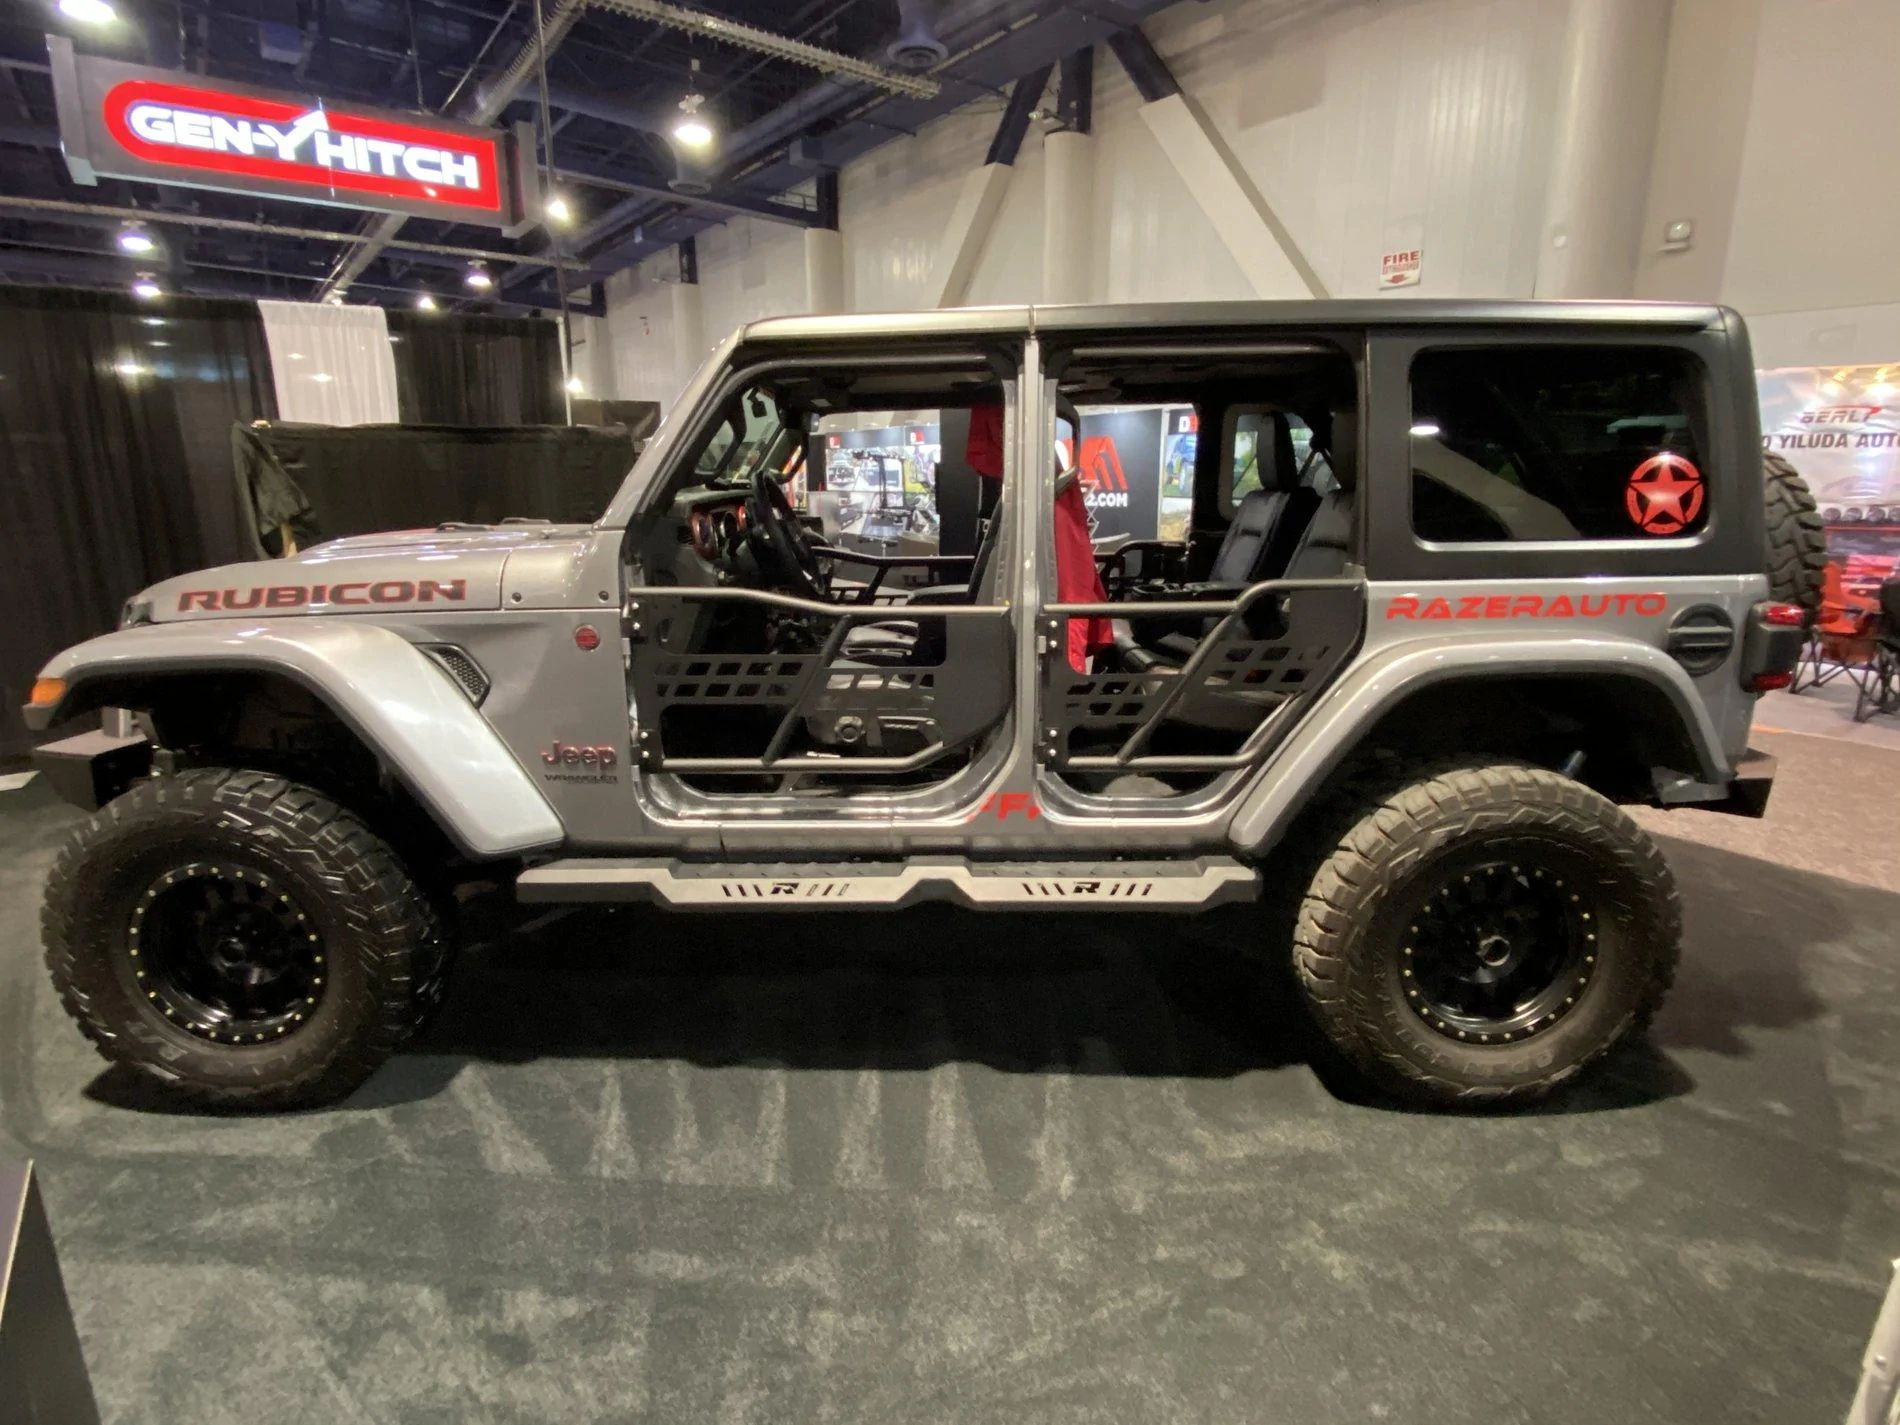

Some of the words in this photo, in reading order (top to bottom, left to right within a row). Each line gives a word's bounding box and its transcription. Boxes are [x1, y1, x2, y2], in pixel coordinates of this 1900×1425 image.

[315, 130, 480, 189] HITCH
[1383, 251, 1420, 266] FIRE
[1780, 433, 1848, 448] YILUDA
[177, 579, 467, 613] RUBICON
[1385, 592, 1667, 621] RAZERAUTO
[541, 740, 617, 768] Jeep
